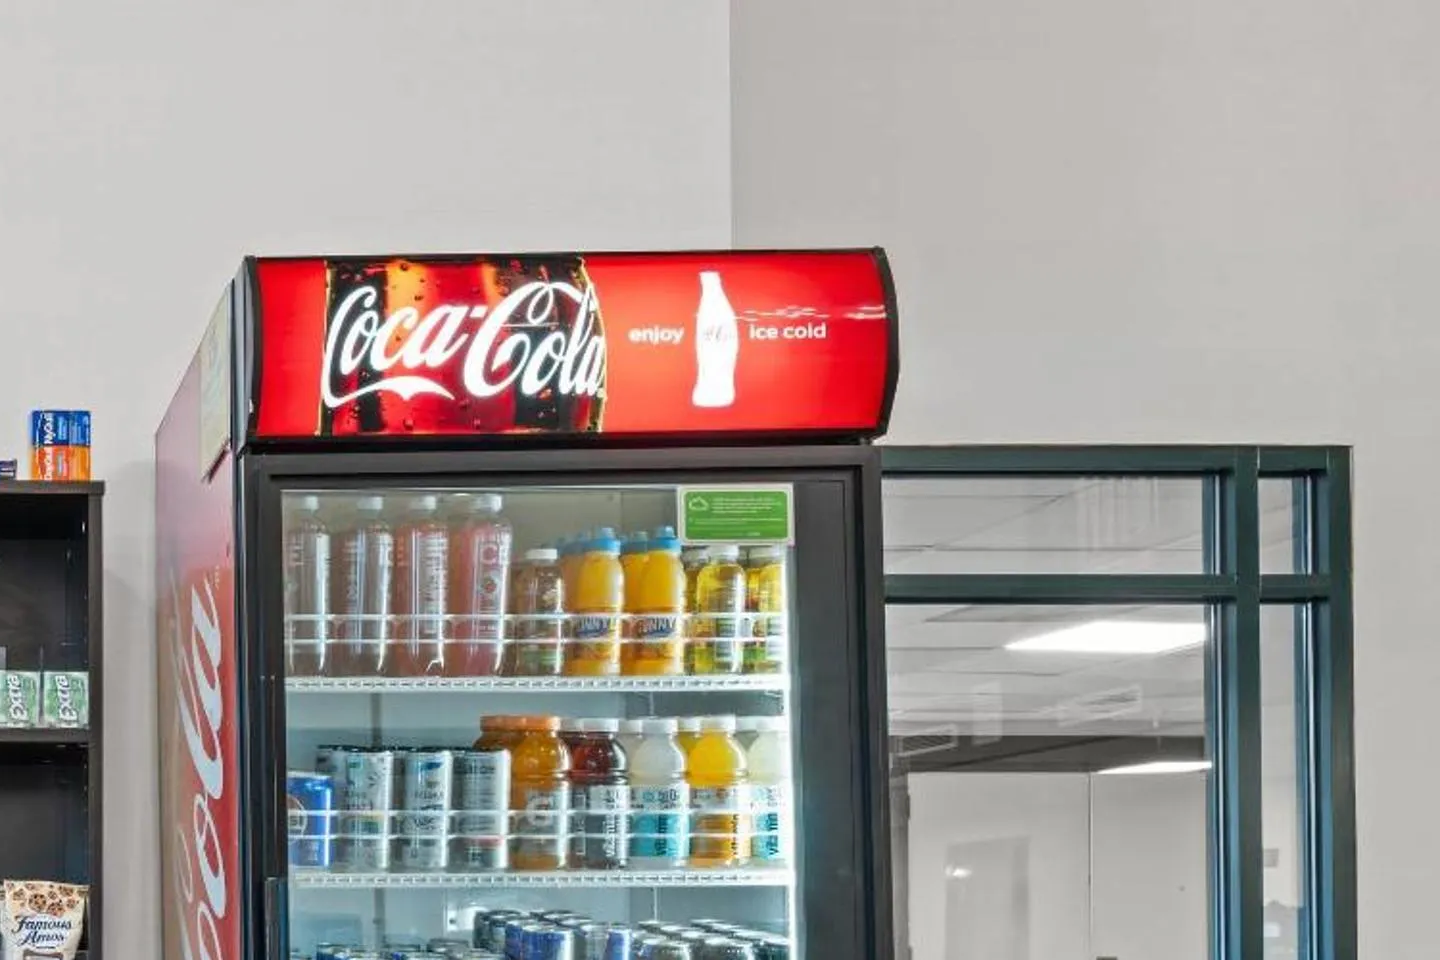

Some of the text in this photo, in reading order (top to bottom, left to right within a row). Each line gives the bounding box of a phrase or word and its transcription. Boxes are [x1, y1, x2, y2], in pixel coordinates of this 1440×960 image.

[628, 325, 685, 344] enjoy
[749, 323, 778, 339] ice
[783, 322, 827, 339] cold
[321, 281, 607, 408] Coca-Cola
[11, 914, 72, 933] Famous
[17, 930, 65, 946] Amos
